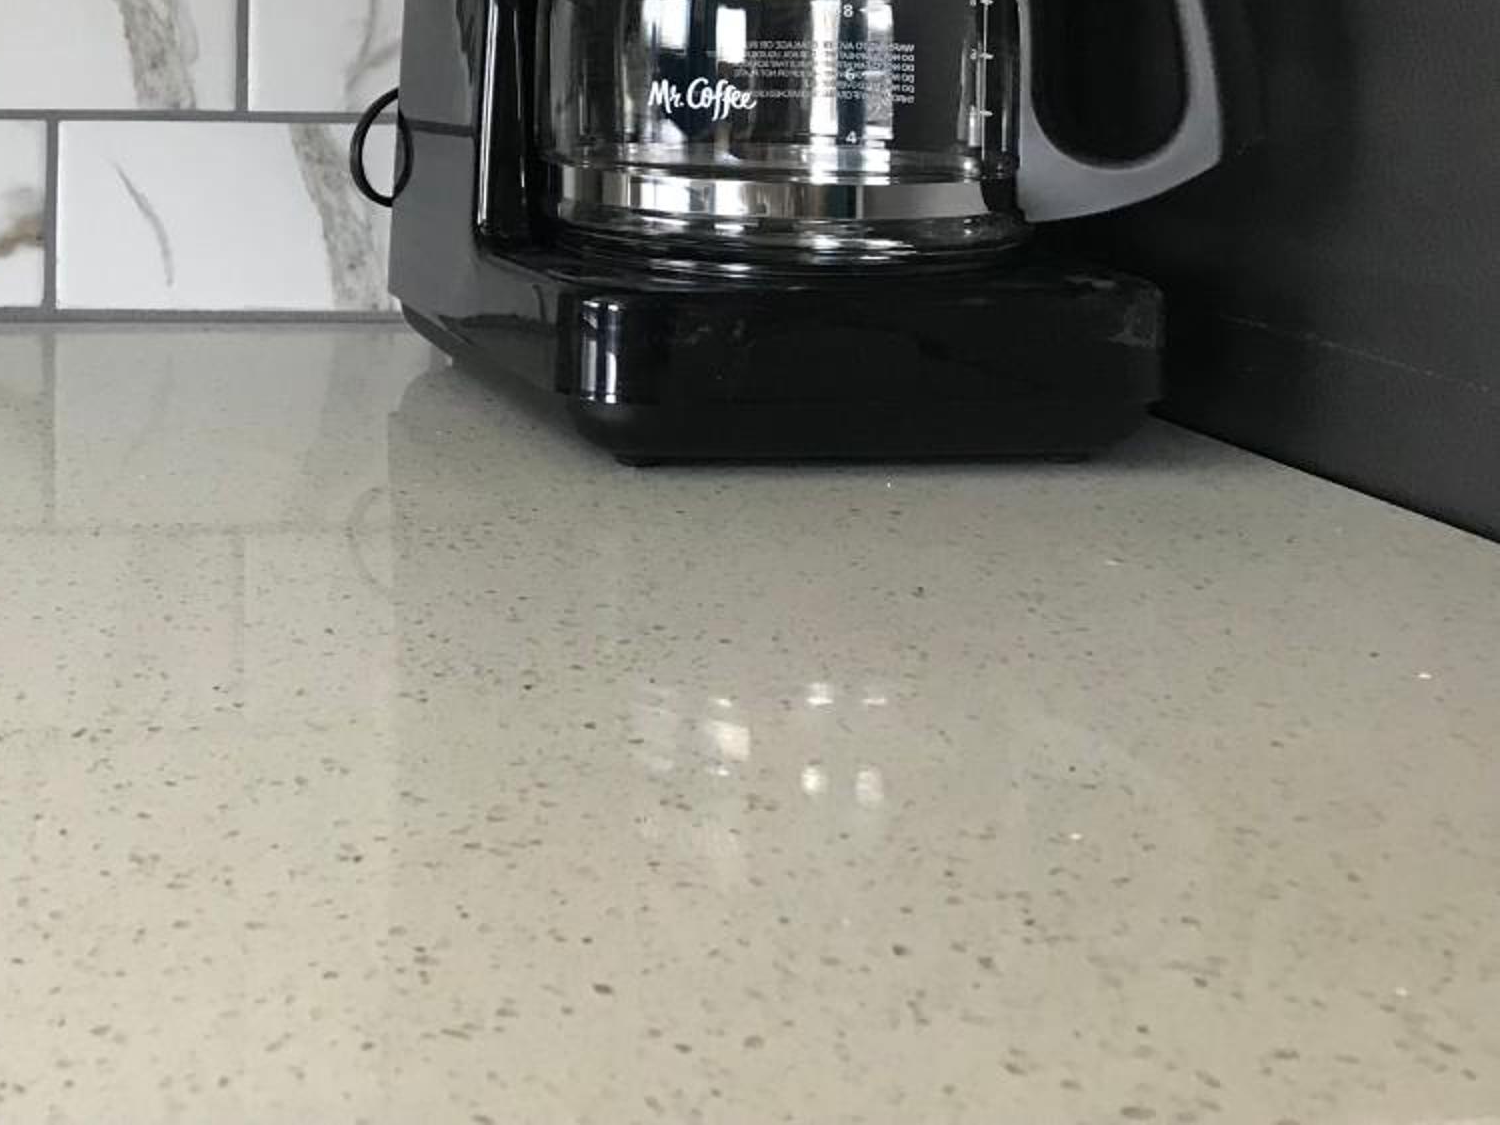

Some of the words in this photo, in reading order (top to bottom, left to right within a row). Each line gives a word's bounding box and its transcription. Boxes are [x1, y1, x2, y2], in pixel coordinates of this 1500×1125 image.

[843, 3, 854, 18] 8
[648, 79, 684, 114] Mr.
[686, 77, 757, 122] Coffee
[845, 130, 858, 144] 4
